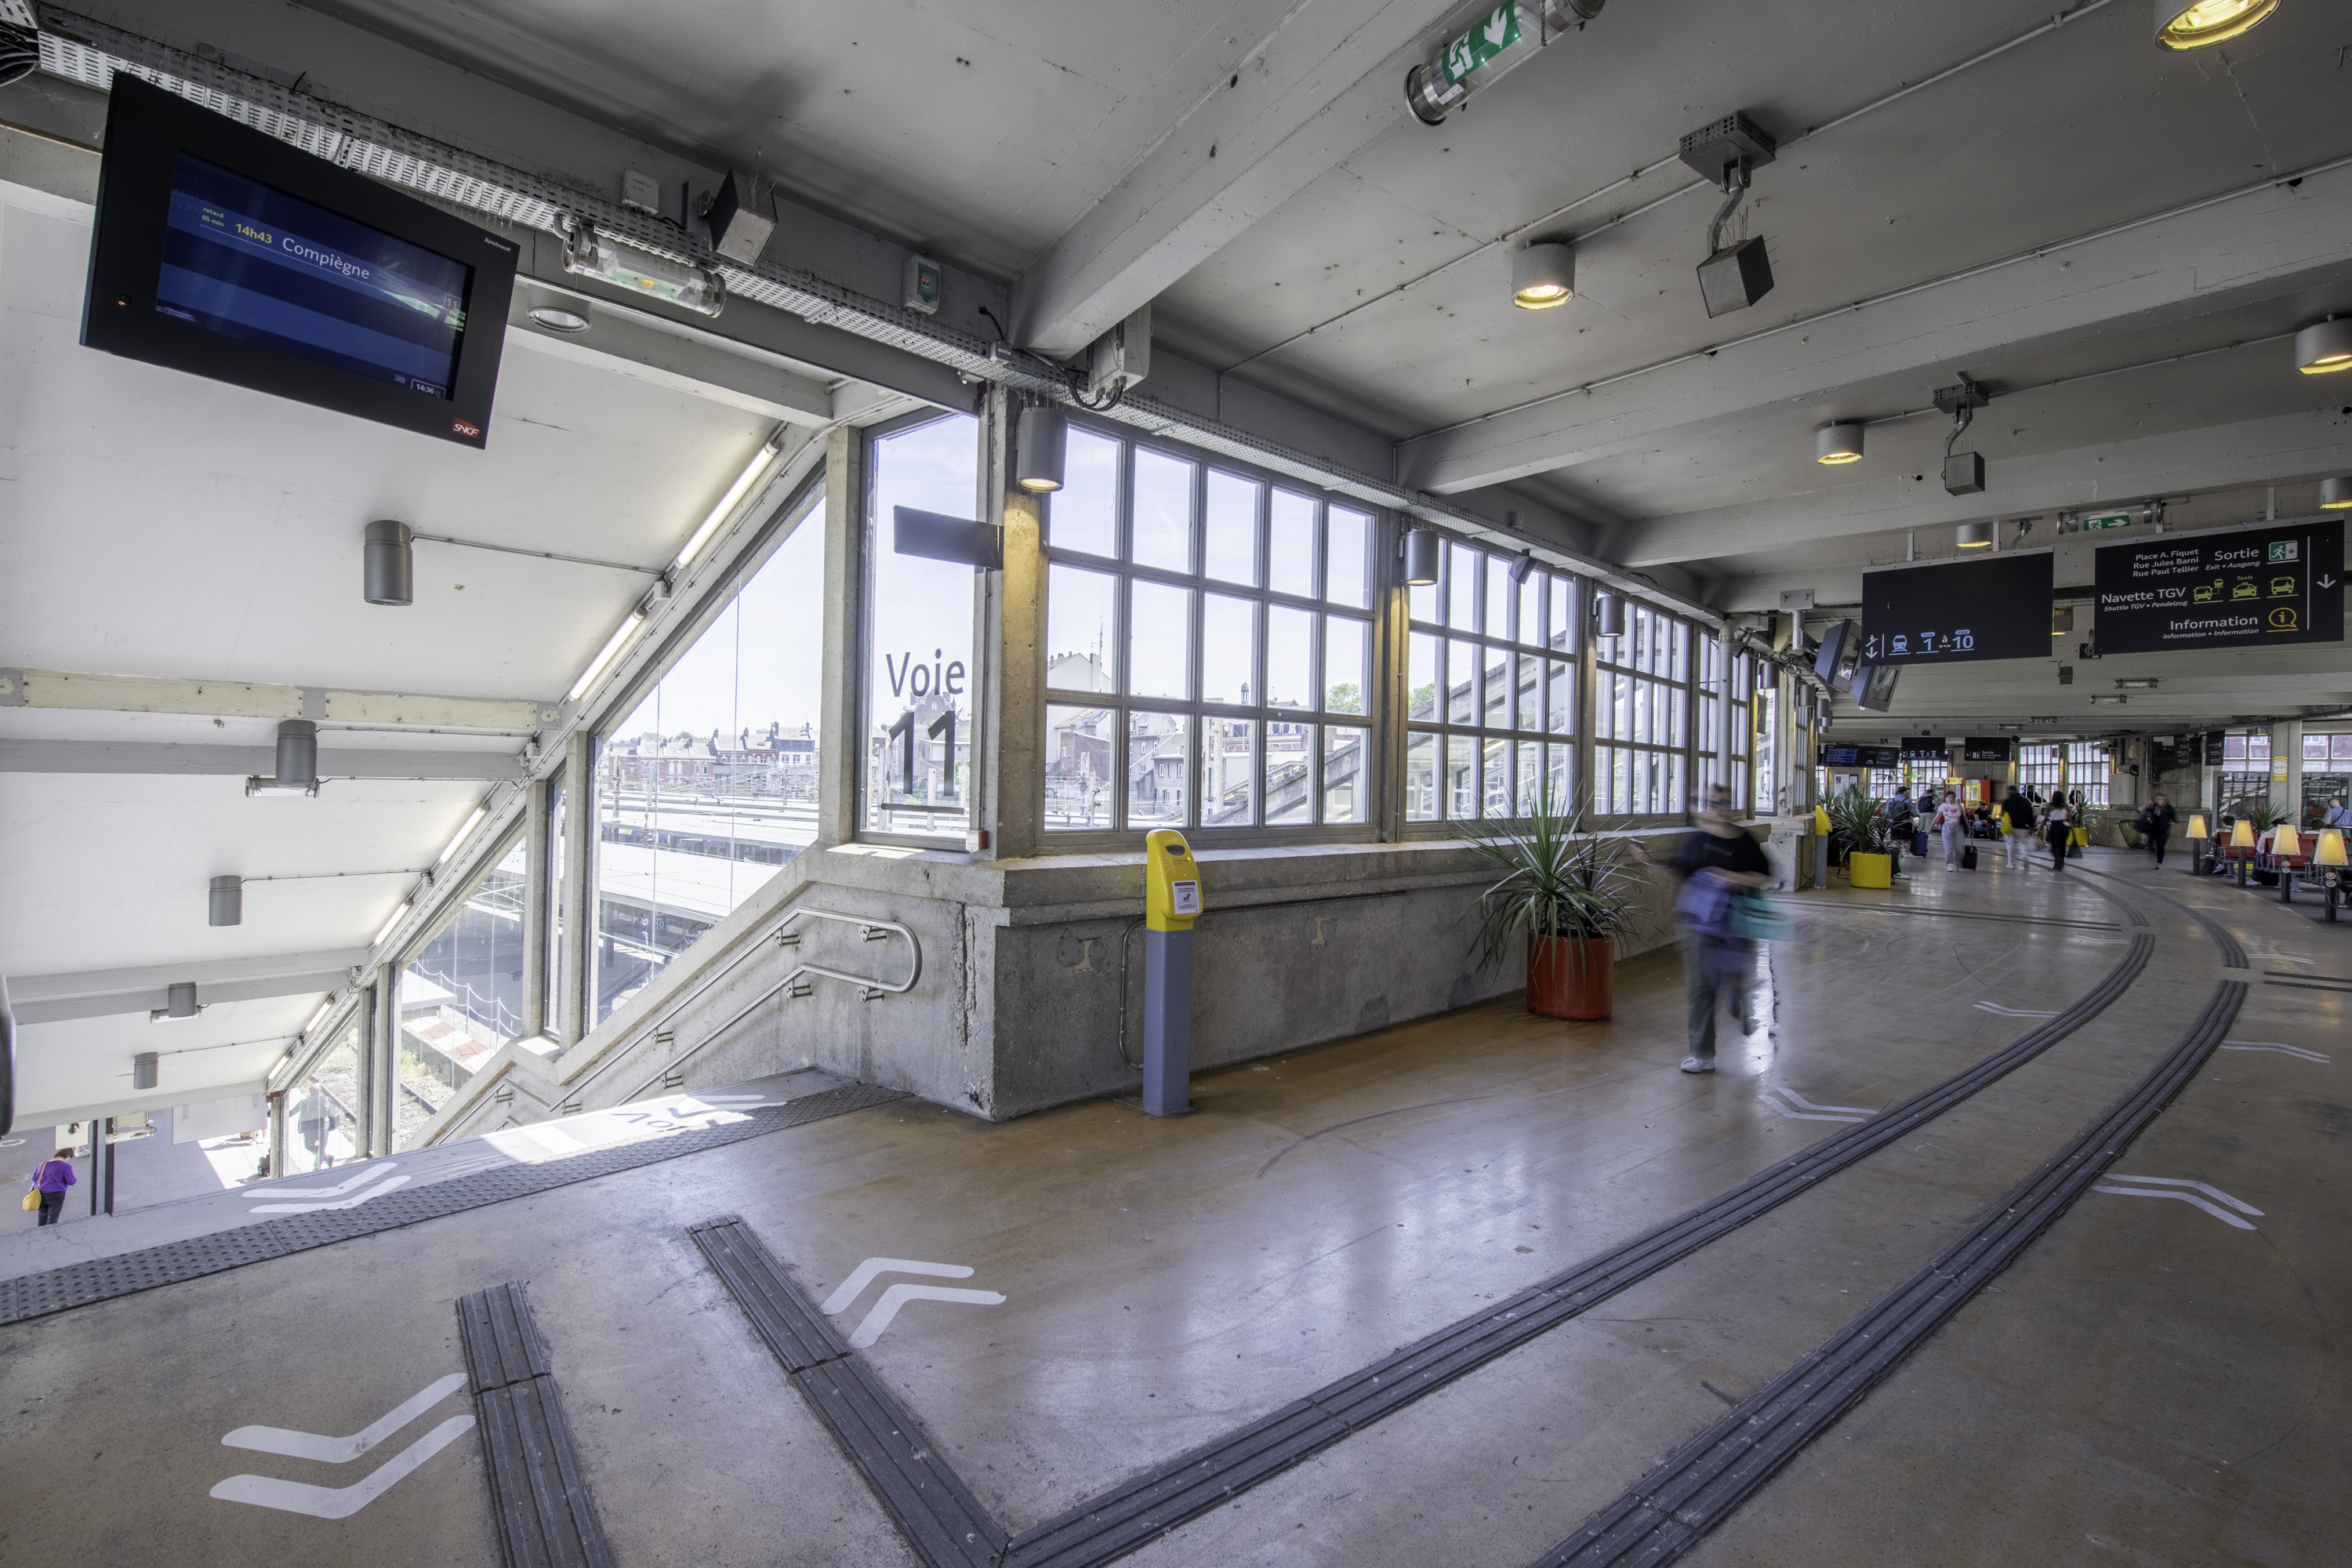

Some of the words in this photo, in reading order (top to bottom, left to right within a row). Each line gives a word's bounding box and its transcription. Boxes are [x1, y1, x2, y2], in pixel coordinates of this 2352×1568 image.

[203, 208, 223, 218] retard
[211, 219, 224, 227] min
[235, 223, 272, 244] 14h43
[282, 238, 370, 279] Compiègne
[485, 237, 511, 252] Synchrosoft
[446, 298, 458, 309] 11
[416, 383, 434, 394] 14:36
[452, 423, 479, 435] SNCF
[2171, 549, 2199, 557] Fiquet
[2214, 548, 2259, 561] Sortie
[2151, 559, 2174, 568] Jules
[2102, 591, 2154, 604] Navette
[2157, 587, 2187, 598] TGV
[2170, 616, 2258, 630] Information
[1923, 637, 1932, 651] 1
[1952, 635, 1974, 649] 10
[886, 648, 965, 698] Voie
[888, 710, 956, 797] 11
